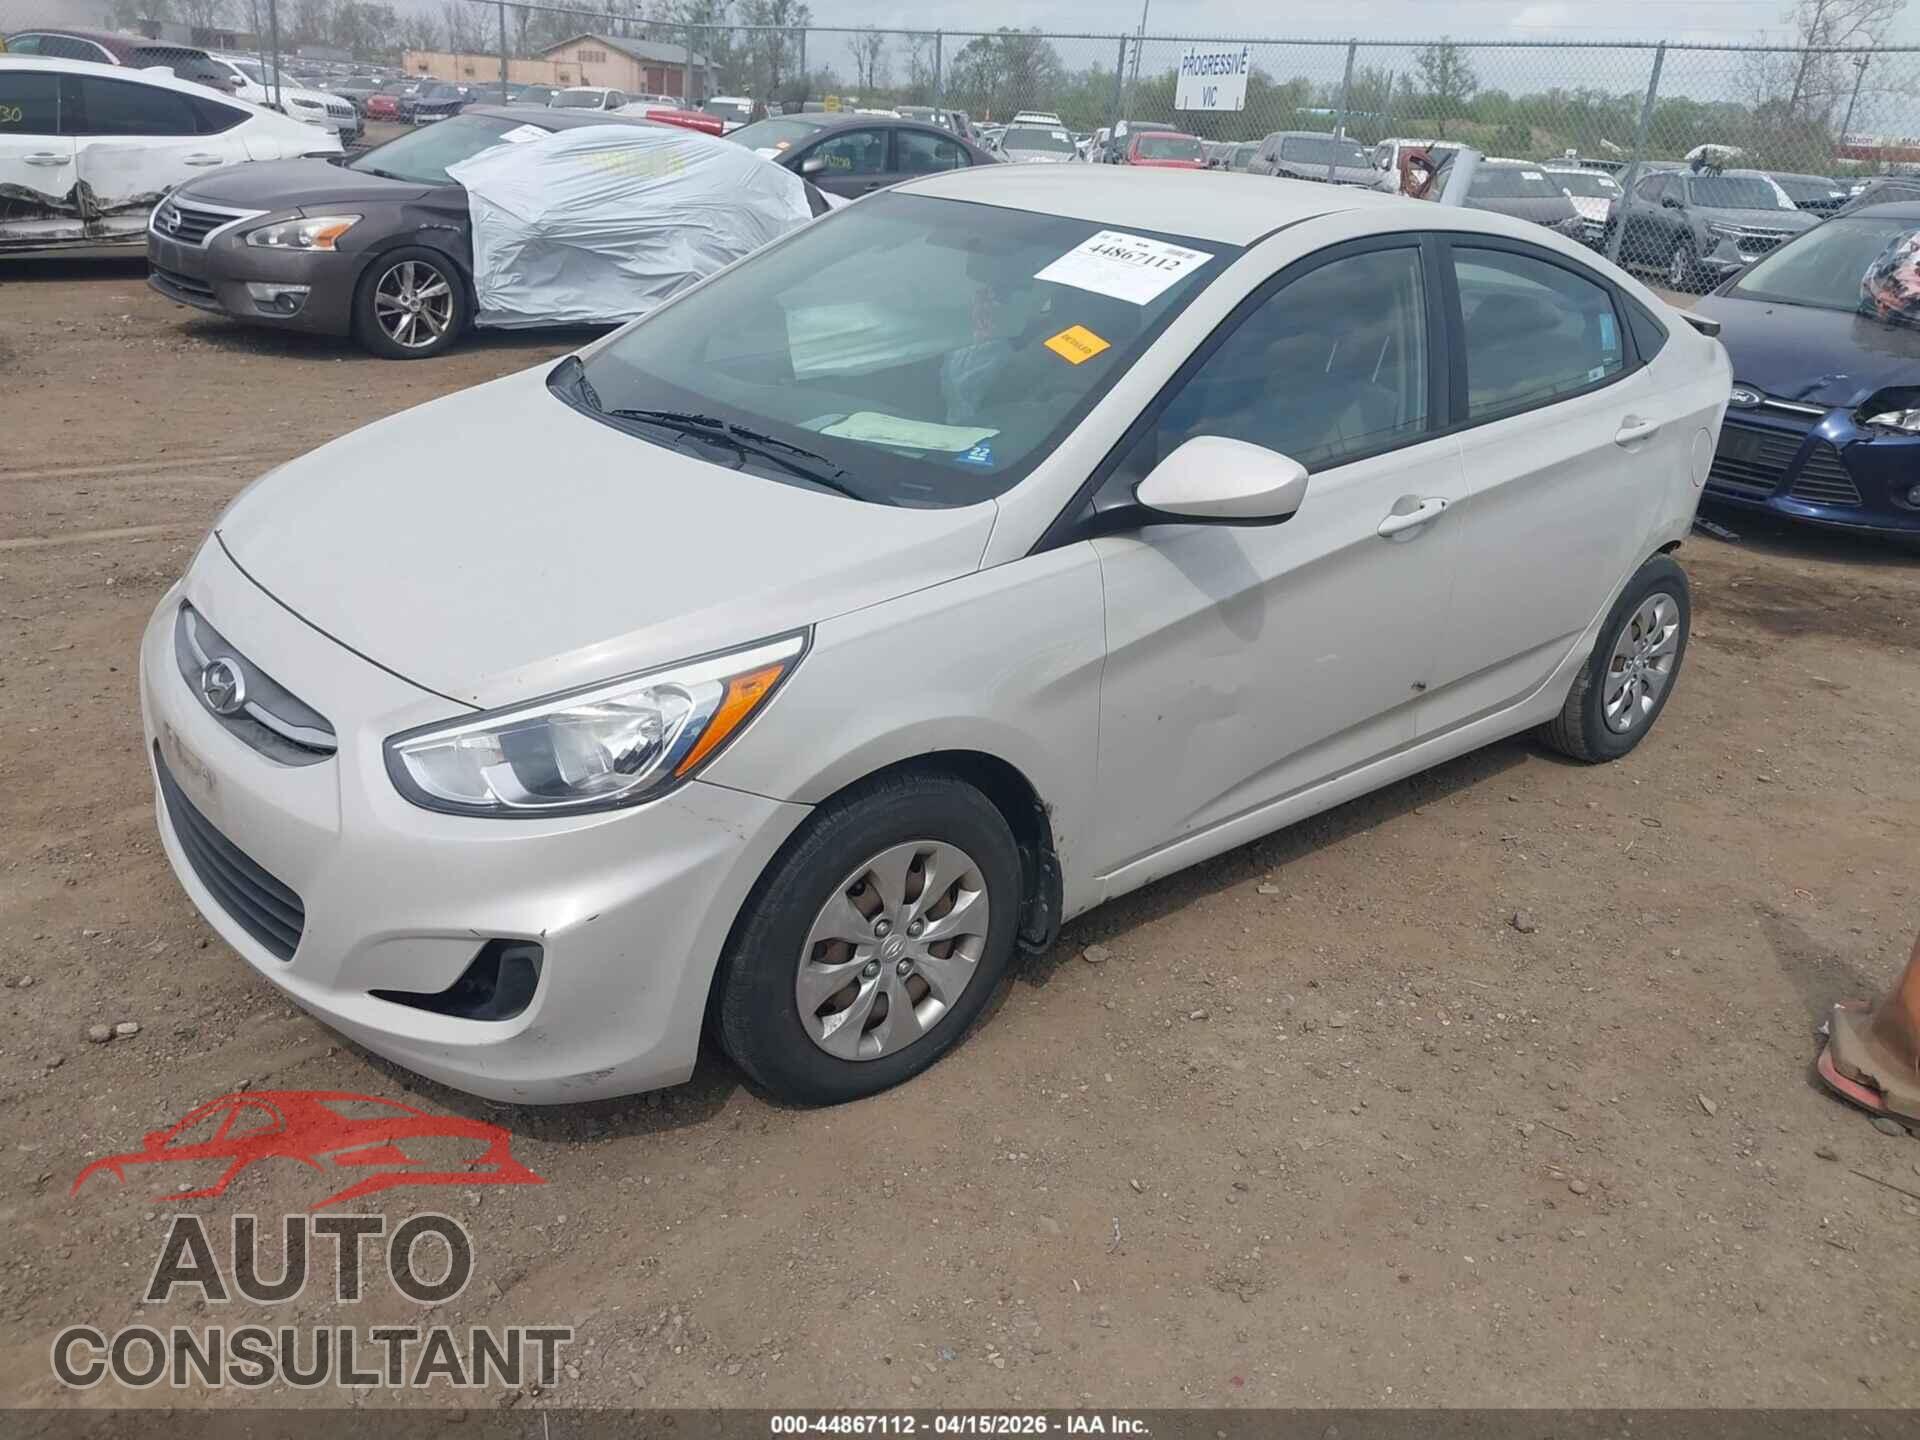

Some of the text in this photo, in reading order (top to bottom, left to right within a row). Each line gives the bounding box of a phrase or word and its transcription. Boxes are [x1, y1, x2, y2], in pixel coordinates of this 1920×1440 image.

[1181, 53, 1248, 76] PROGRESSIVE
[1202, 86, 1218, 107] VIC
[1089, 243, 1181, 271] 44867112
